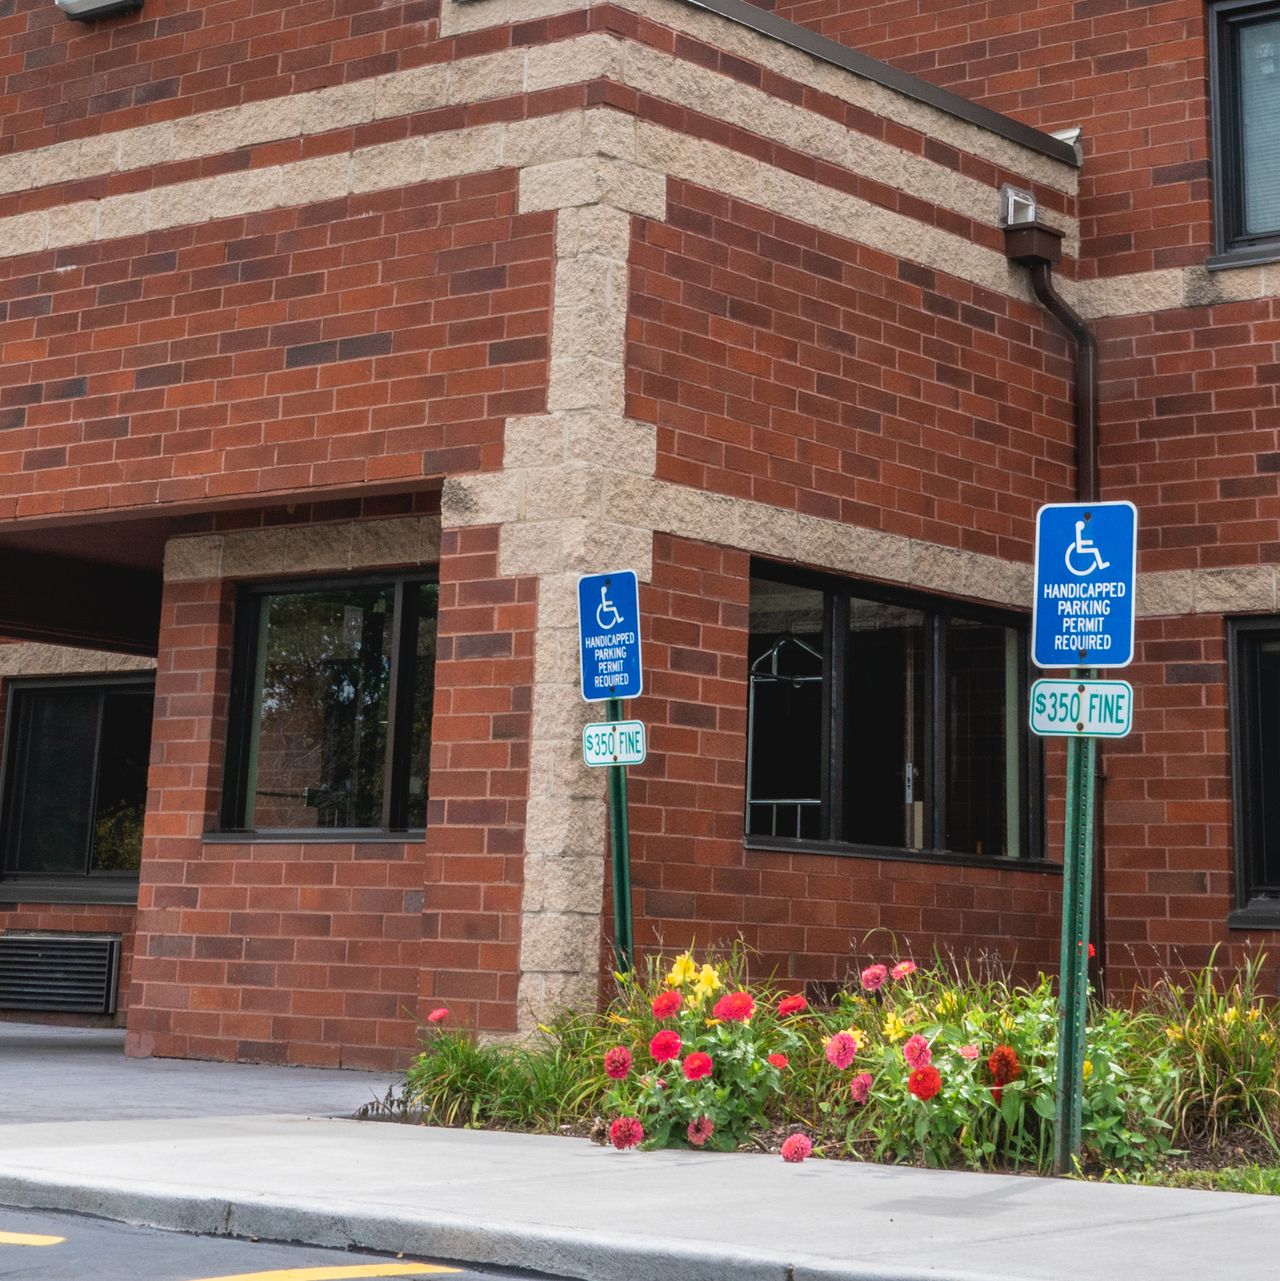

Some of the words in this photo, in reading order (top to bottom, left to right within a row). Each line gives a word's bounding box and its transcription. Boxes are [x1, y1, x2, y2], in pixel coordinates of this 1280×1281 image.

[1043, 582, 1126, 600] HANDICAPPED
[1057, 600, 1111, 616] PARKING
[1062, 617, 1105, 633] PERMIT
[585, 631, 635, 649] HANDICAPPED
[1054, 634, 1112, 651] REQUIRED
[594, 646, 627, 661] PARKING
[598, 660, 624, 673] PERMIT
[594, 673, 629, 688] REQUIRED
[1035, 692, 1081, 723] $350
[1088, 694, 1126, 725] FINE
[586, 732, 615, 757] $350
[619, 730, 642, 755] FINE
